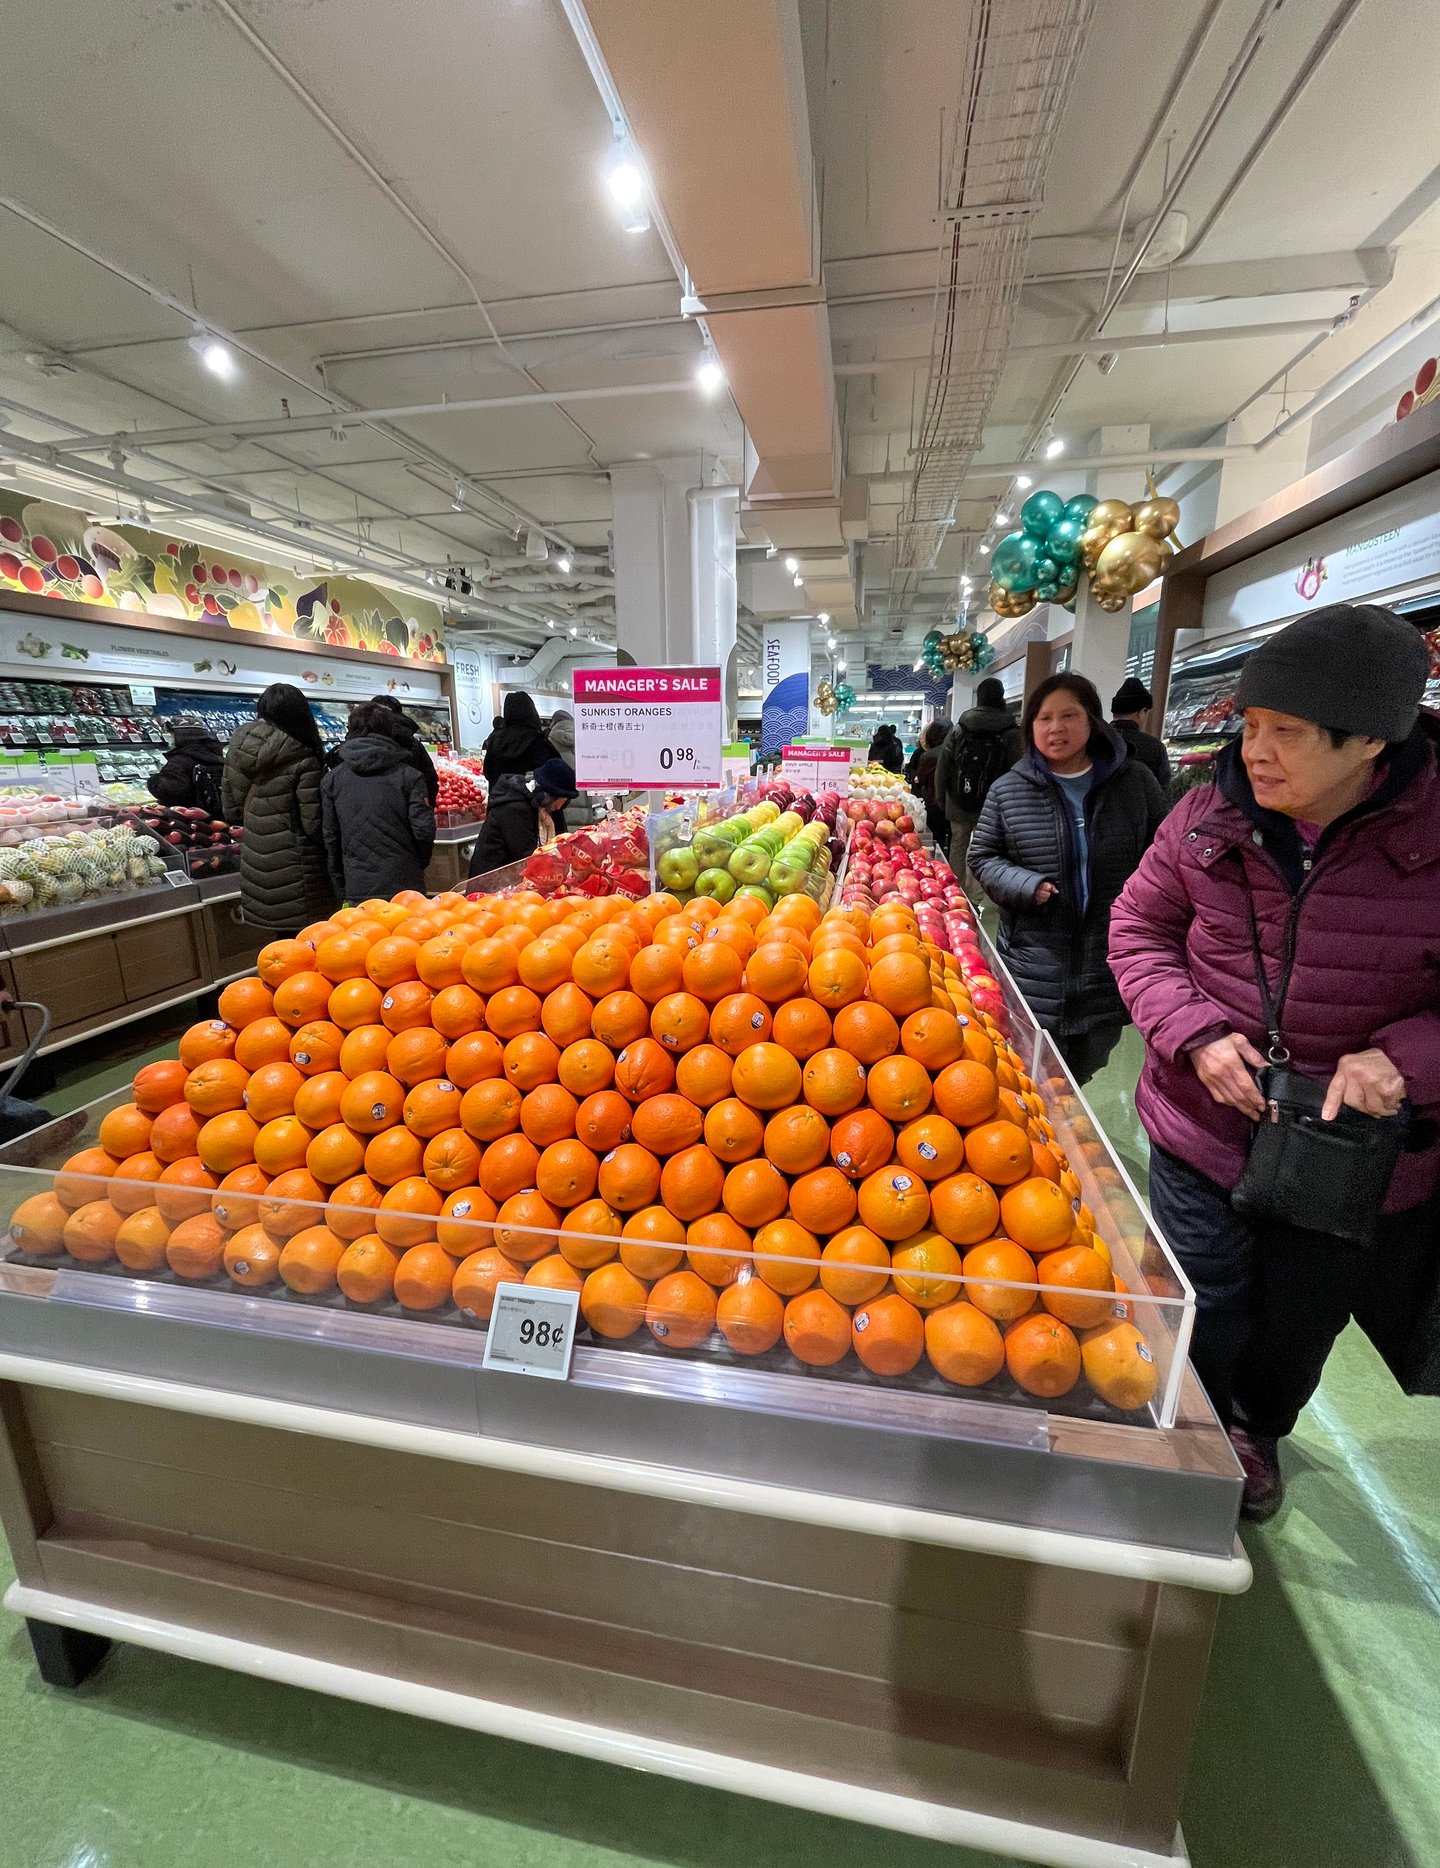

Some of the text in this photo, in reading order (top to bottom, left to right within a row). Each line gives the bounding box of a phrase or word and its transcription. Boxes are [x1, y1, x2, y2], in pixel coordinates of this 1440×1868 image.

[1345, 527, 1401, 557] MANGOSTEEN
[456, 662, 479, 676] FRESH
[767, 639, 780, 685] SEAFOOD
[585, 678, 708, 692] MANAGER'S SALE
[581, 707, 672, 717] SUNKIST ORANGES
[519, 1318, 564, 1348] 98¢
